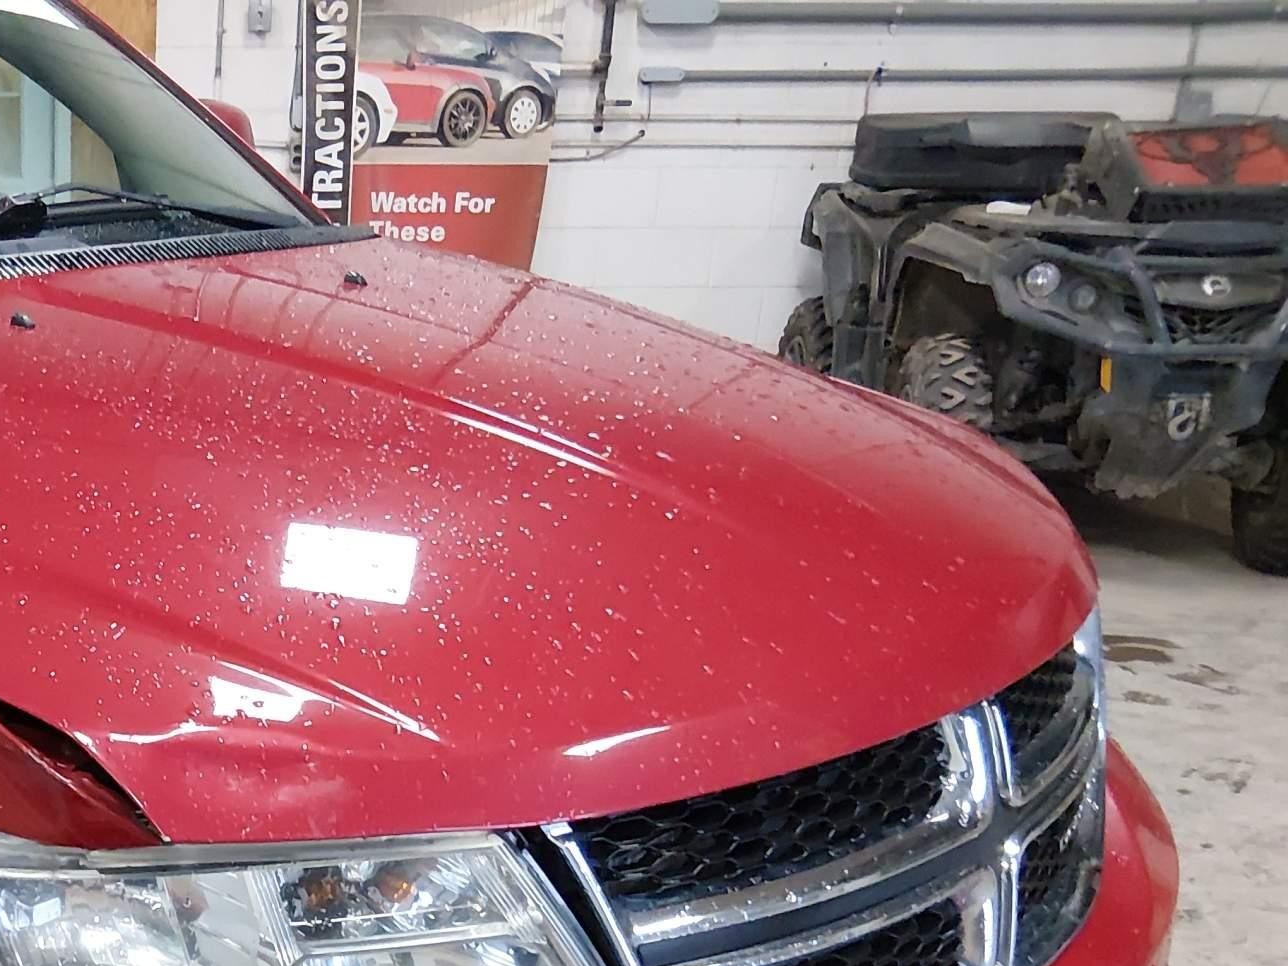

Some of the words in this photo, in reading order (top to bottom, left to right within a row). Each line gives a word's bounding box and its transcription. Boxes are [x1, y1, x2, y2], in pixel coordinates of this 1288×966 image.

[312, 0, 349, 223] TRACTIONS
[371, 191, 446, 213] Watch
[454, 191, 495, 213] For
[369, 220, 446, 242] These
